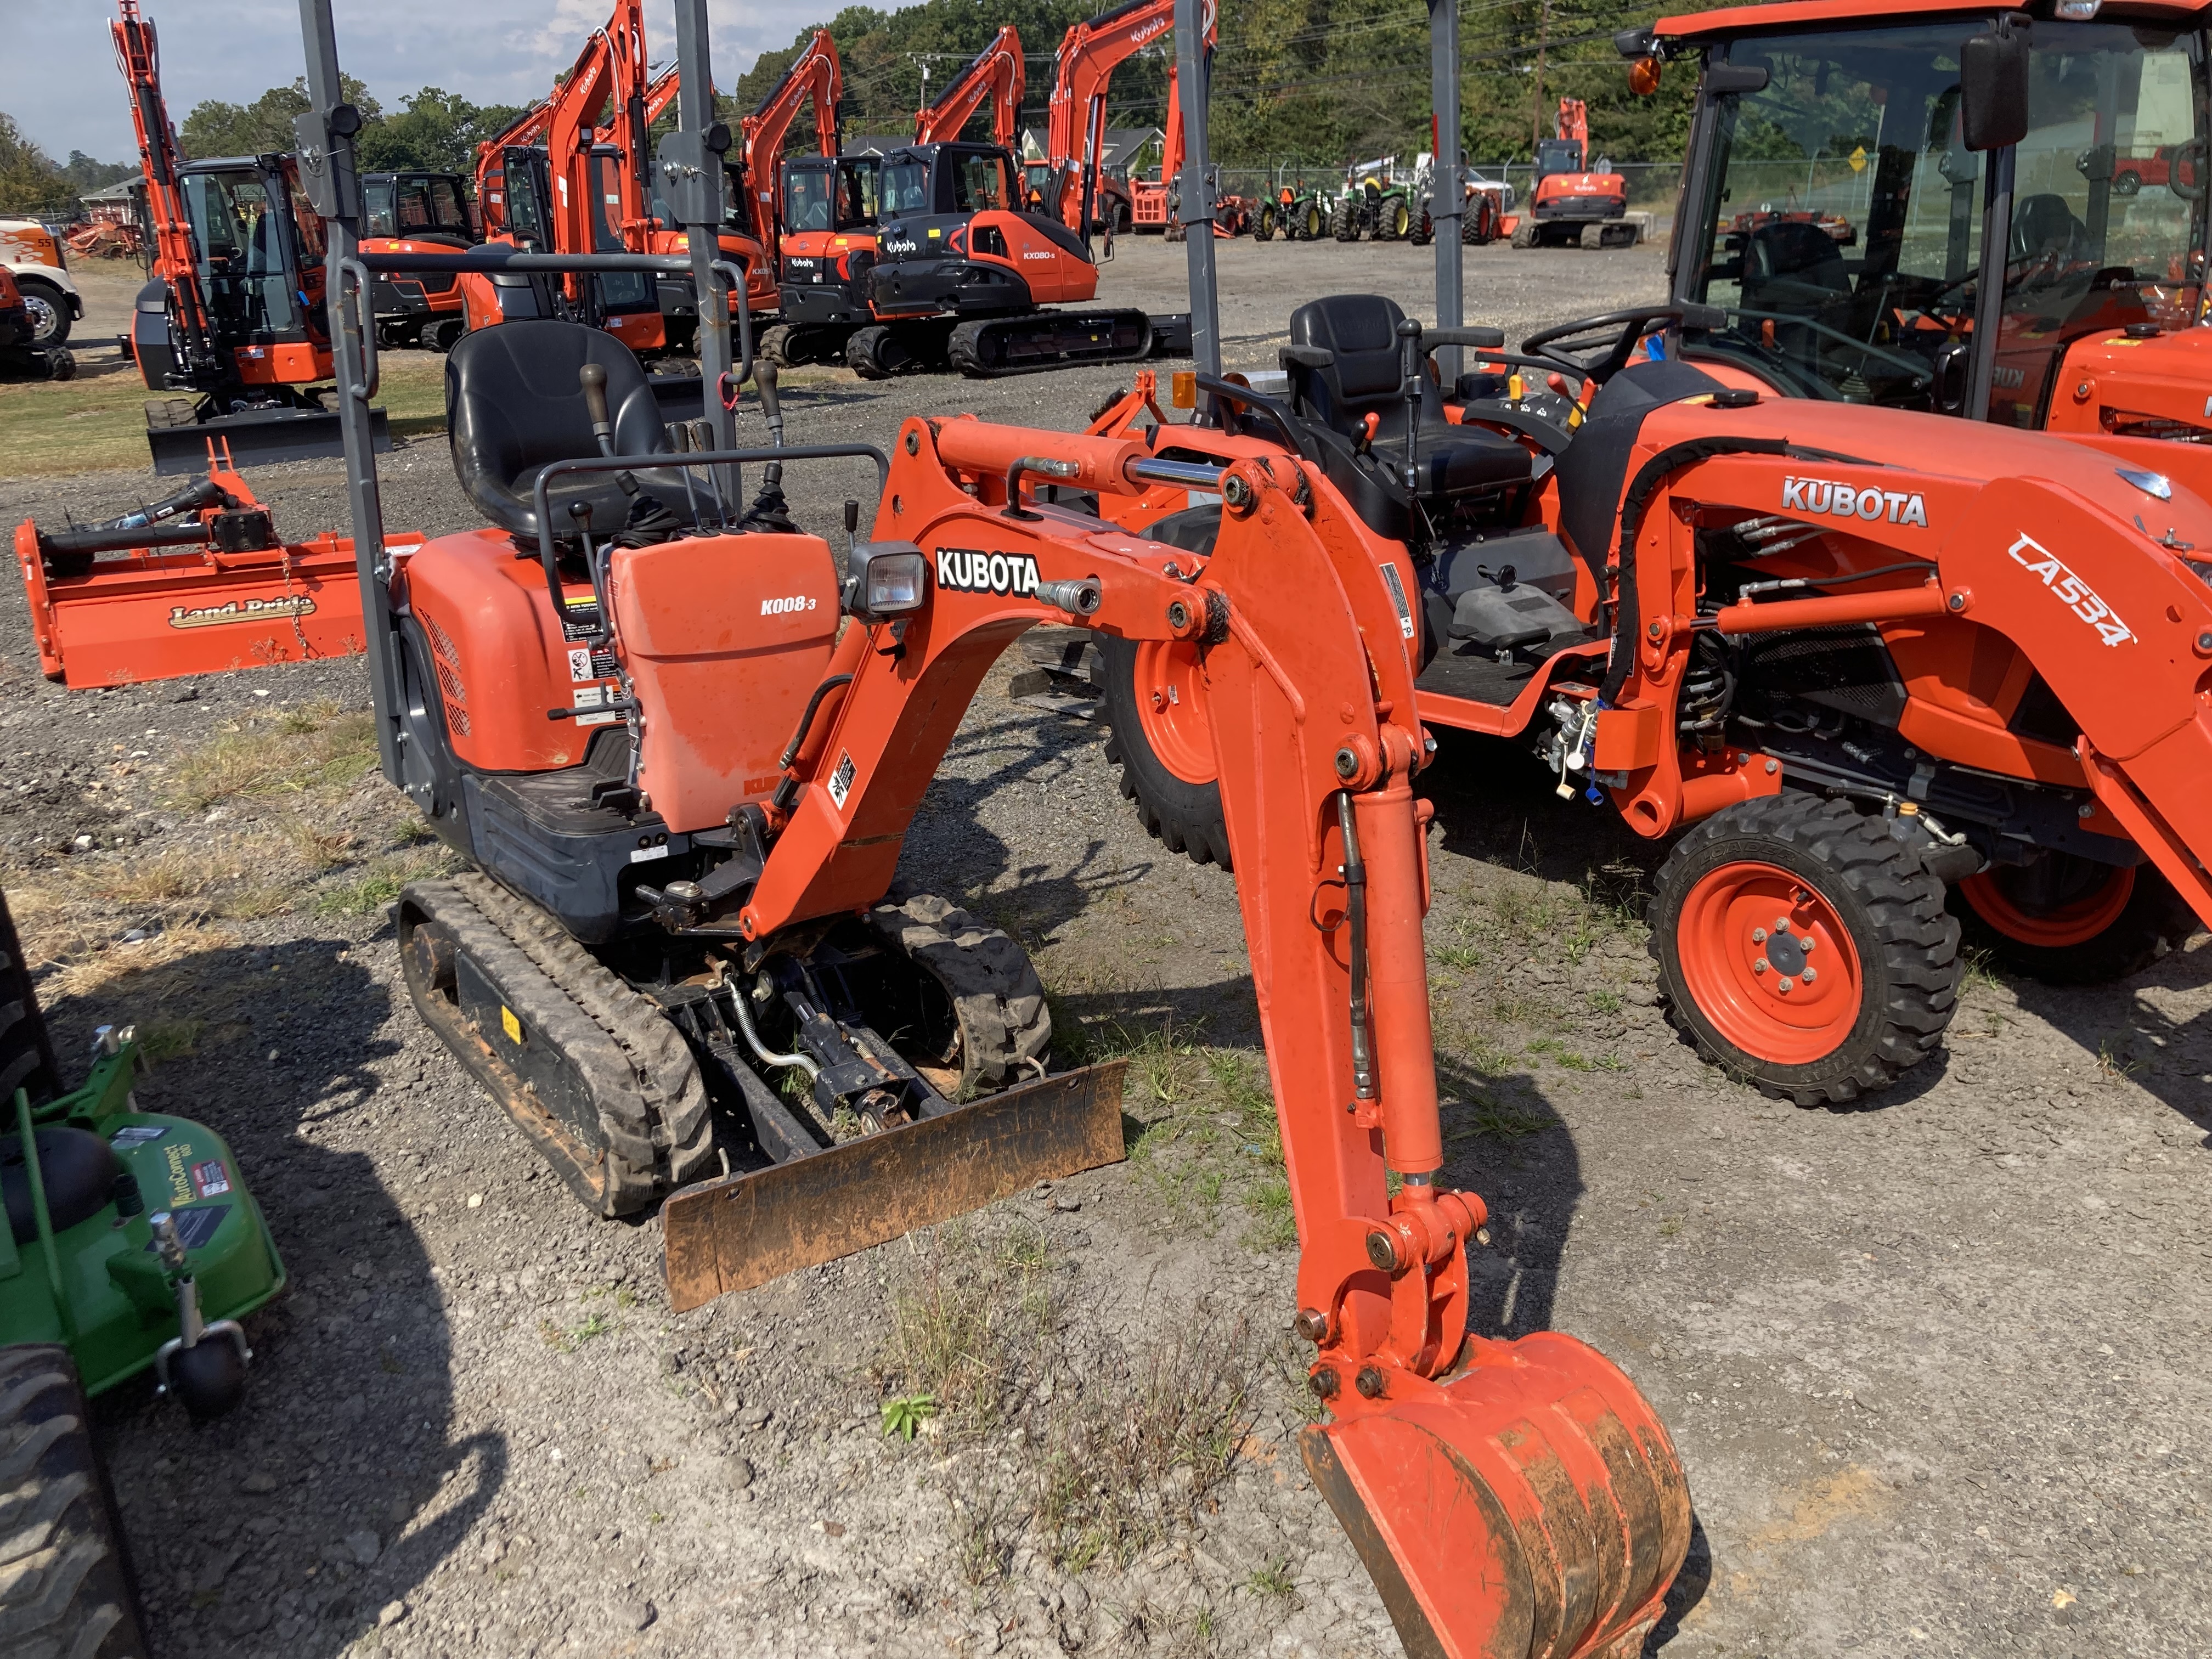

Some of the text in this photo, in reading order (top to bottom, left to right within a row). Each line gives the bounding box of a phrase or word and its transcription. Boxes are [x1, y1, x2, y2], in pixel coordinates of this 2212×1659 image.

[1130, 18, 1165, 43] Kubota
[579, 66, 596, 95] Kubota
[967, 81, 986, 104] Kubota
[789, 85, 806, 108] Kubota
[520, 124, 541, 143] Kubota
[38, 239, 51, 247] 55
[887, 239, 916, 253] Kubota
[792, 258, 814, 267] Kubota
[1782, 478, 1929, 528] KUBOTA
[936, 550, 1041, 593] KUBOTA
[2007, 538, 2131, 648] LA534
[172, 596, 312, 623] Land Pride
[760, 595, 816, 616] K008-3
[163, 1144, 191, 1200] AutoConnect
